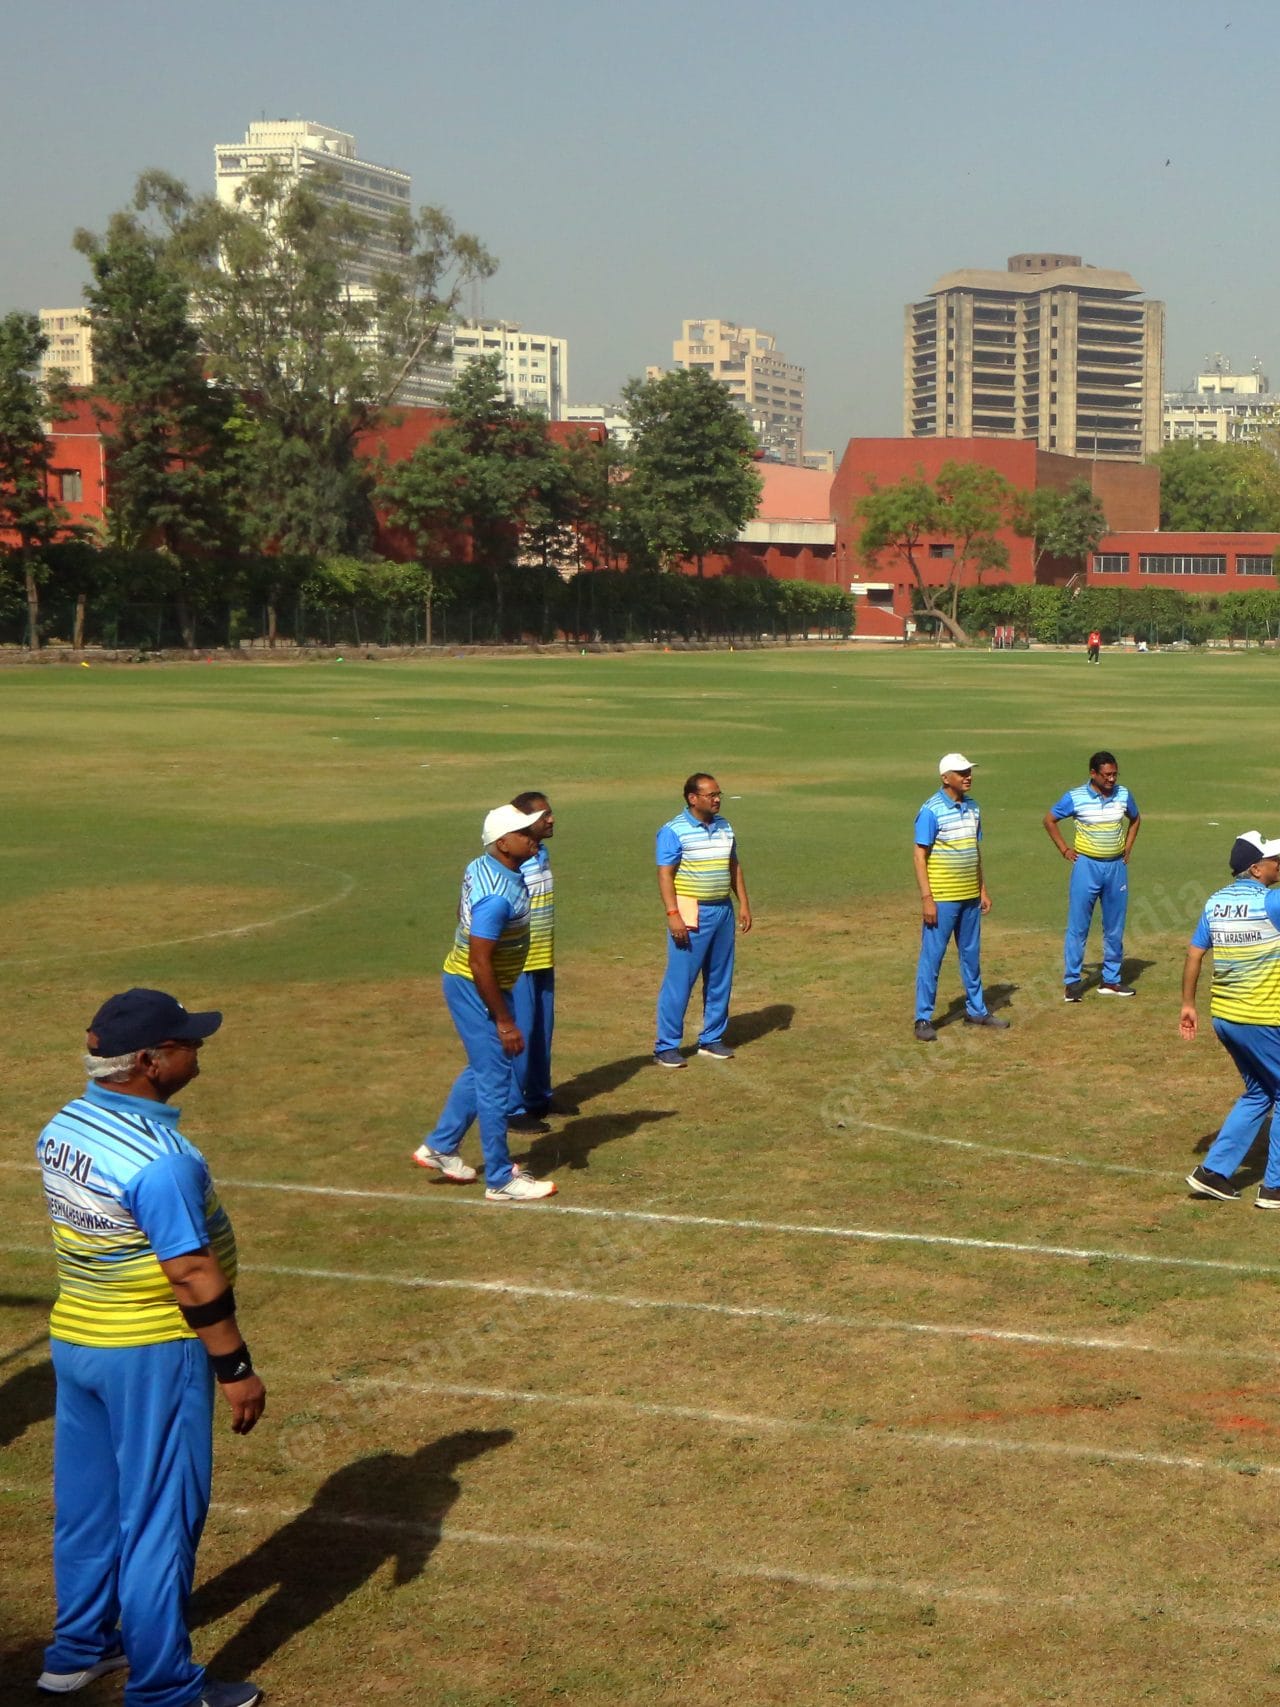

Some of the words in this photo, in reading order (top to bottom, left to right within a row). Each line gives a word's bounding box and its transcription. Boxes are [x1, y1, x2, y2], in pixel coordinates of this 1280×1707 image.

[1213, 904, 1232, 918] CJI
[1233, 904, 1249, 918] XI
[44, 1138, 70, 1172] CJI
[69, 1149, 93, 1184] XI
